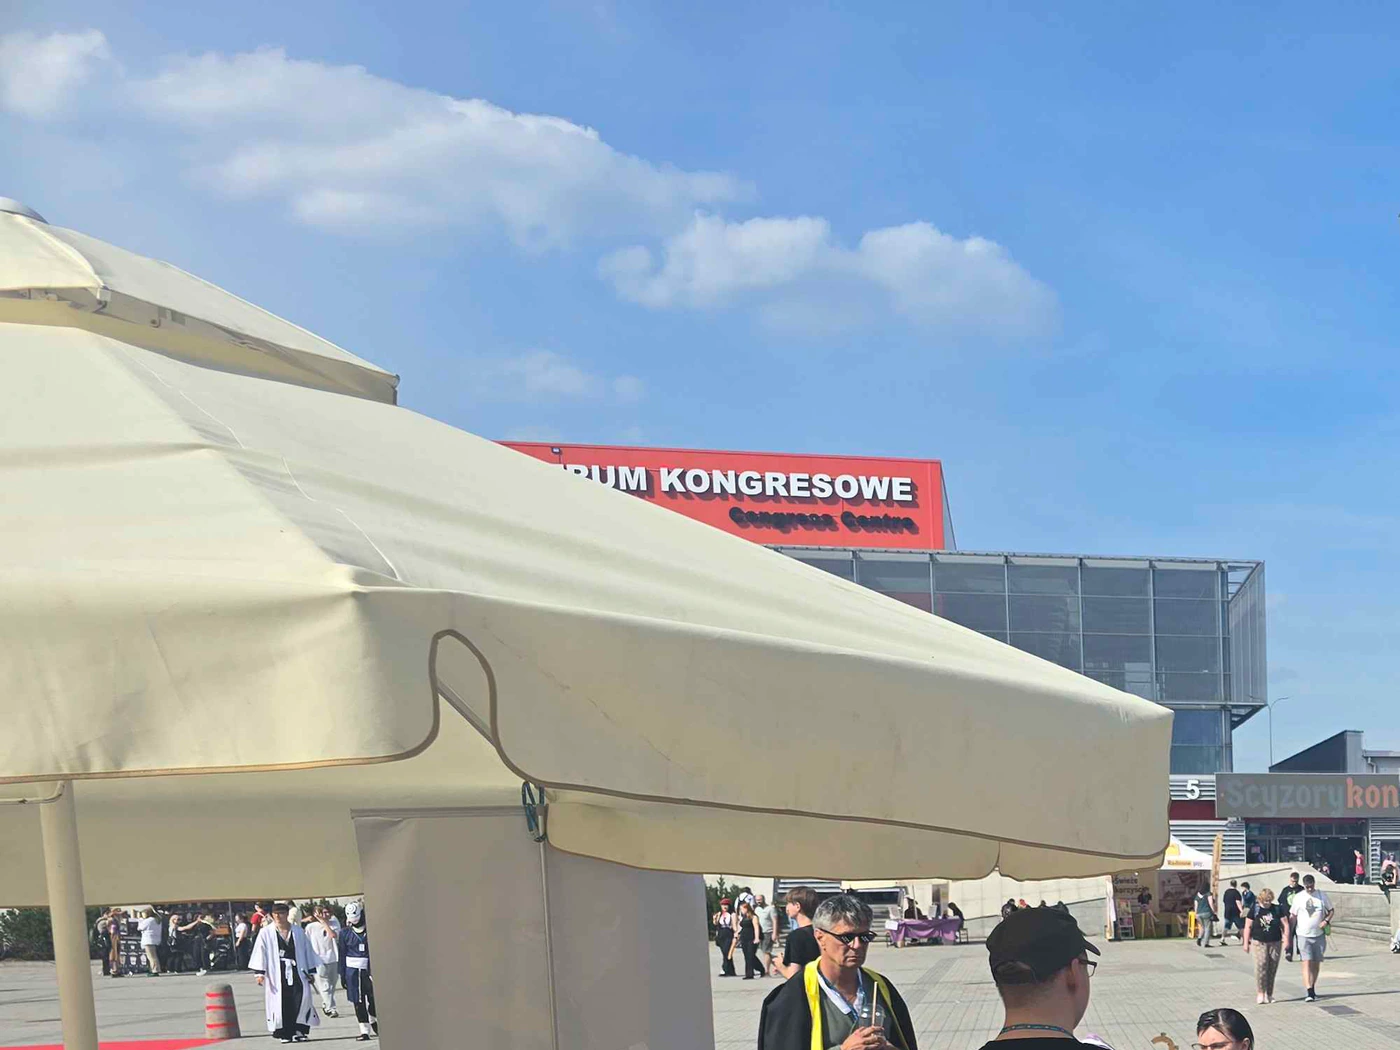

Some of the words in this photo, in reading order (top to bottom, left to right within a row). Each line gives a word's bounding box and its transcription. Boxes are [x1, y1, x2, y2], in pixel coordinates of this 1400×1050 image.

[660, 467, 914, 501] KONGRESOWE
[1186, 779, 1200, 800] 5
[1226, 778, 1399, 816] Scyzorykon
